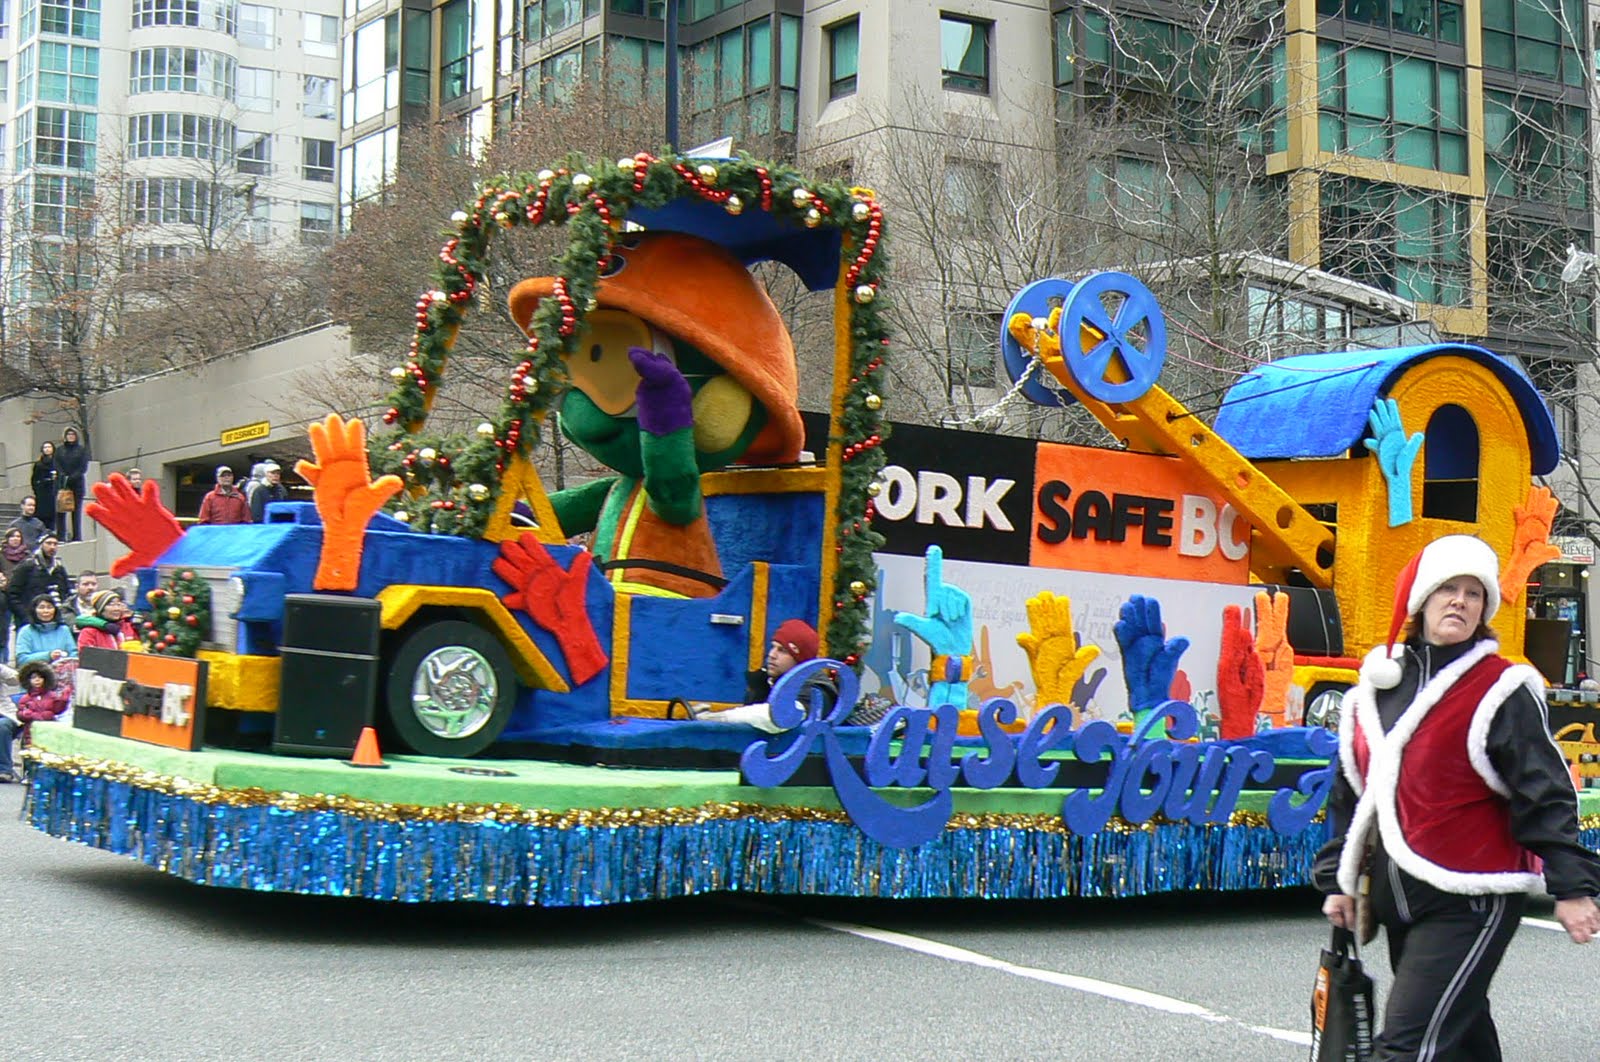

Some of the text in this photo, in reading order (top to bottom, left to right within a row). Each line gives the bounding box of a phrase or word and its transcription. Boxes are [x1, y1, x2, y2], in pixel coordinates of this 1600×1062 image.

[873, 465, 1016, 532] ORK
[75, 668, 127, 711] WORK
[741, 658, 1072, 848] Raise
[1062, 700, 1274, 836] Your
